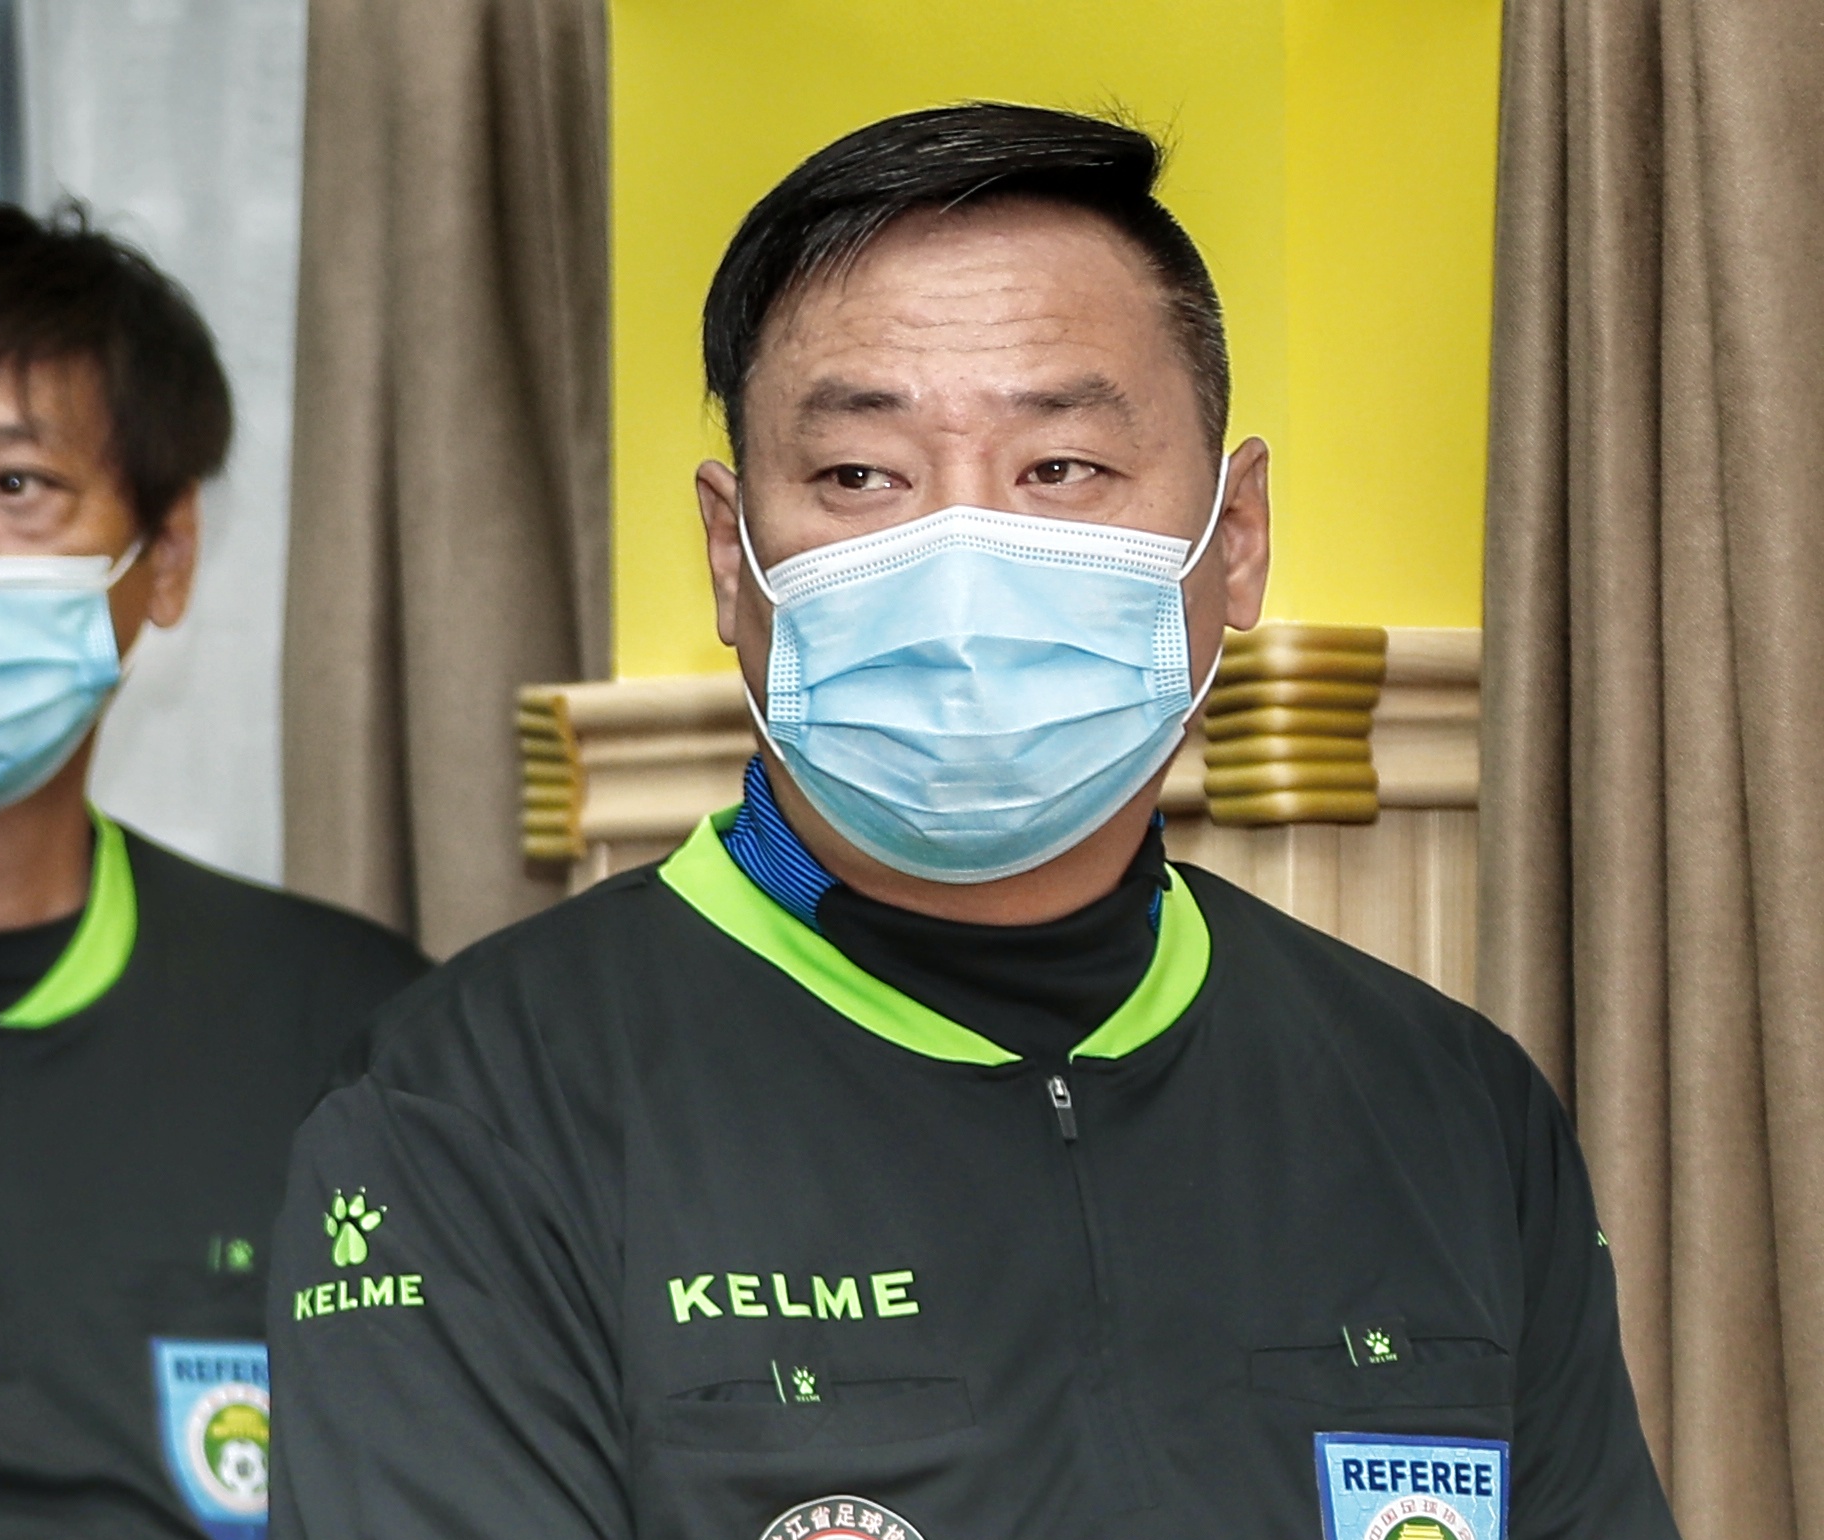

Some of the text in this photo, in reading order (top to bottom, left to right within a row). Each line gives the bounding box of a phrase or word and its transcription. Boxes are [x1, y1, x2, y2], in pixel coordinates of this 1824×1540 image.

[294, 1274, 424, 1321] KELME
[667, 1270, 920, 1324] KELME
[1342, 1458, 1494, 1498] REFEREE
